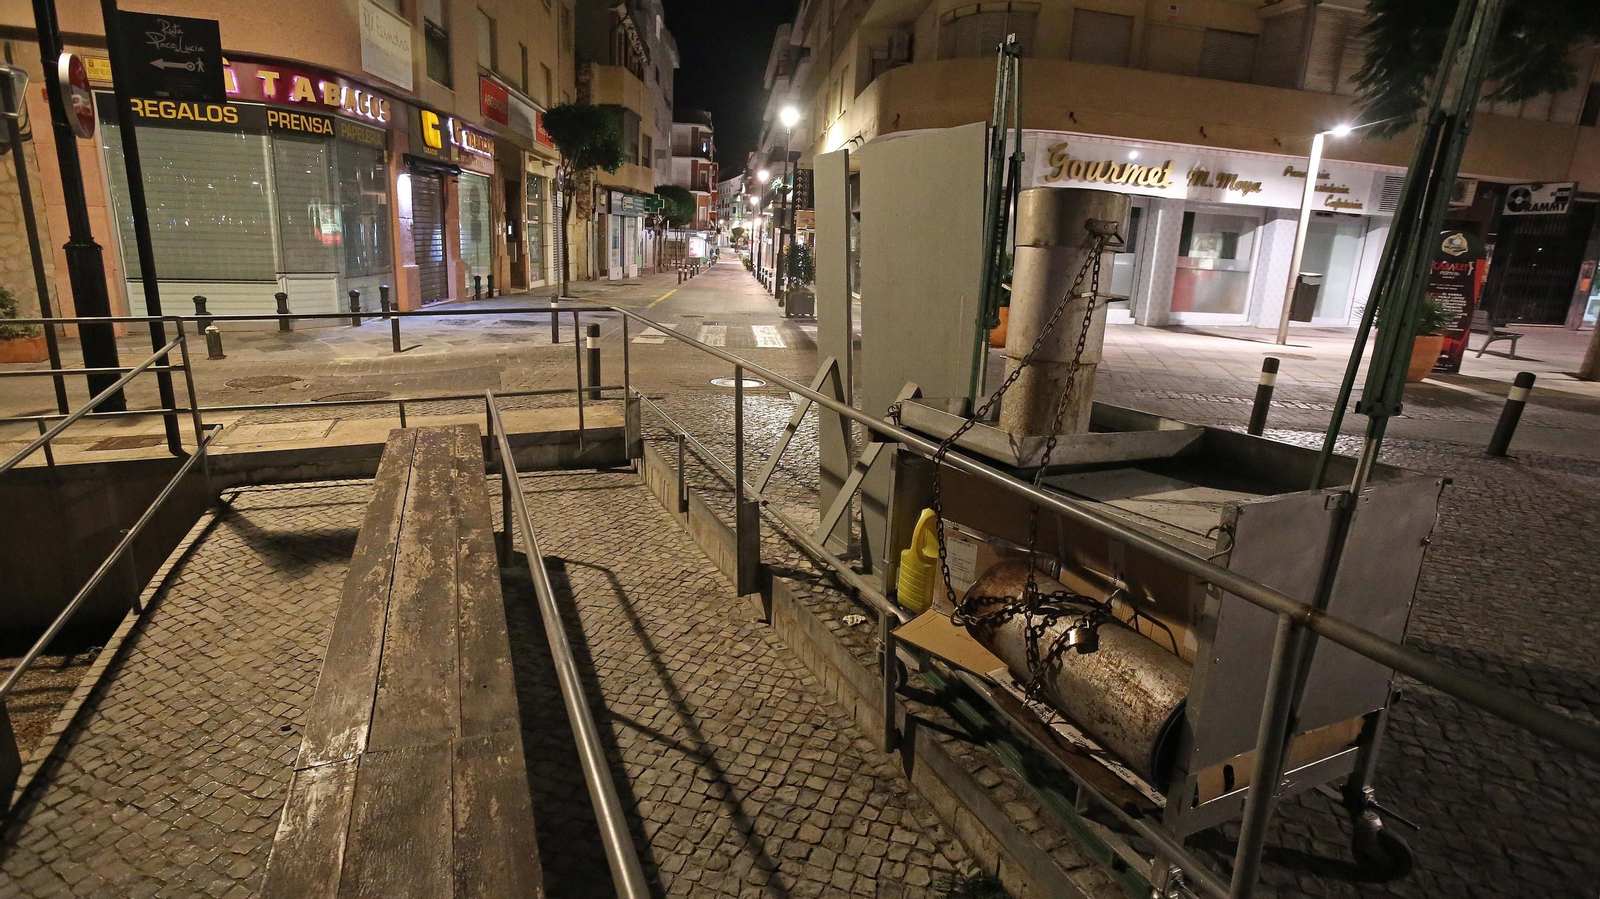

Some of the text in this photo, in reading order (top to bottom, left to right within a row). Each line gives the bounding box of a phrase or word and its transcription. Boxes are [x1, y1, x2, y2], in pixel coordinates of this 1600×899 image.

[145, 31, 176, 50] Paco
[157, 18, 184, 38] Ruta
[257, 69, 391, 122] TABACOS
[130, 98, 239, 124] REGALOS
[267, 109, 335, 136] PRENSA
[1045, 142, 1177, 189] Gourmet
[1216, 172, 1262, 197] Moya
[1433, 261, 1470, 272] CABARET
